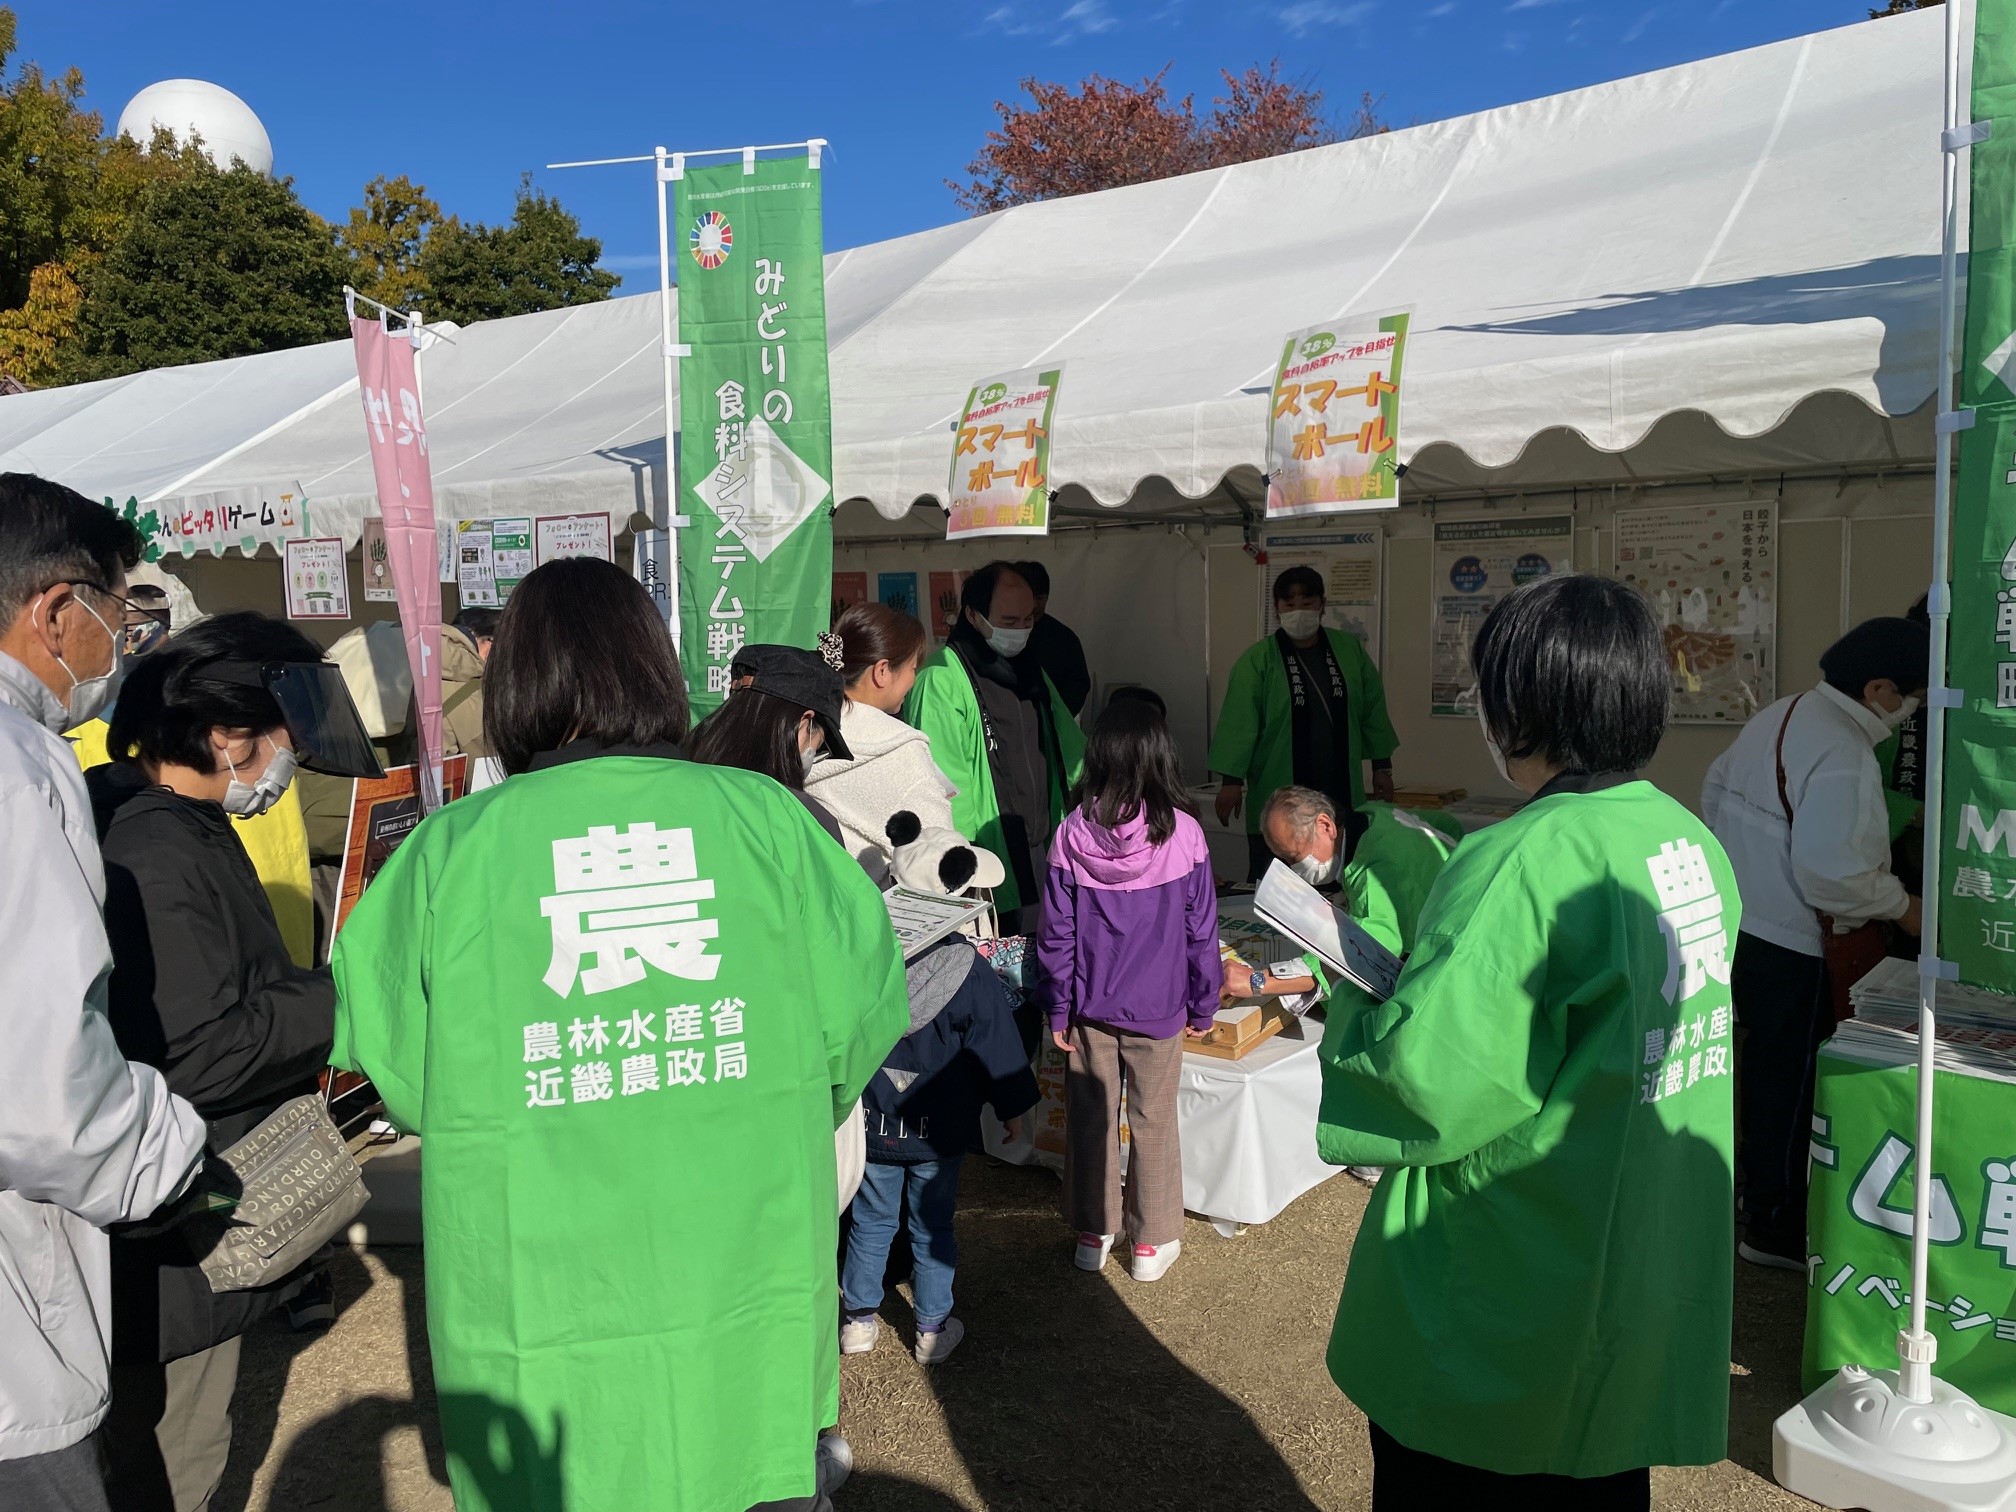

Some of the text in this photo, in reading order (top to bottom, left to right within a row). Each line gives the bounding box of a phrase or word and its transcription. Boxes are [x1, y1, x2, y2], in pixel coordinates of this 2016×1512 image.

[754, 258, 794, 424] みどりの
[1301, 338, 1334, 356] 38%
[1273, 371, 1399, 419] スマート
[956, 418, 1048, 457] スマート
[707, 379, 747, 701] 食料システム戦略
[997, 503, 1035, 526] 無料
[1756, 508, 1769, 558] 餃子から
[642, 558, 659, 581] 食
[1741, 509, 1753, 584] 日本を考える
[539, 822, 722, 999] 農
[1646, 837, 1731, 1007] 農
[523, 997, 746, 1063] 農林水産省
[1642, 1003, 1733, 1065] 農林水産
[525, 1041, 748, 1109] 近畿農政局
[1640, 1043, 1733, 1106] 近畿農政
[863, 1107, 929, 1140] ELLE
